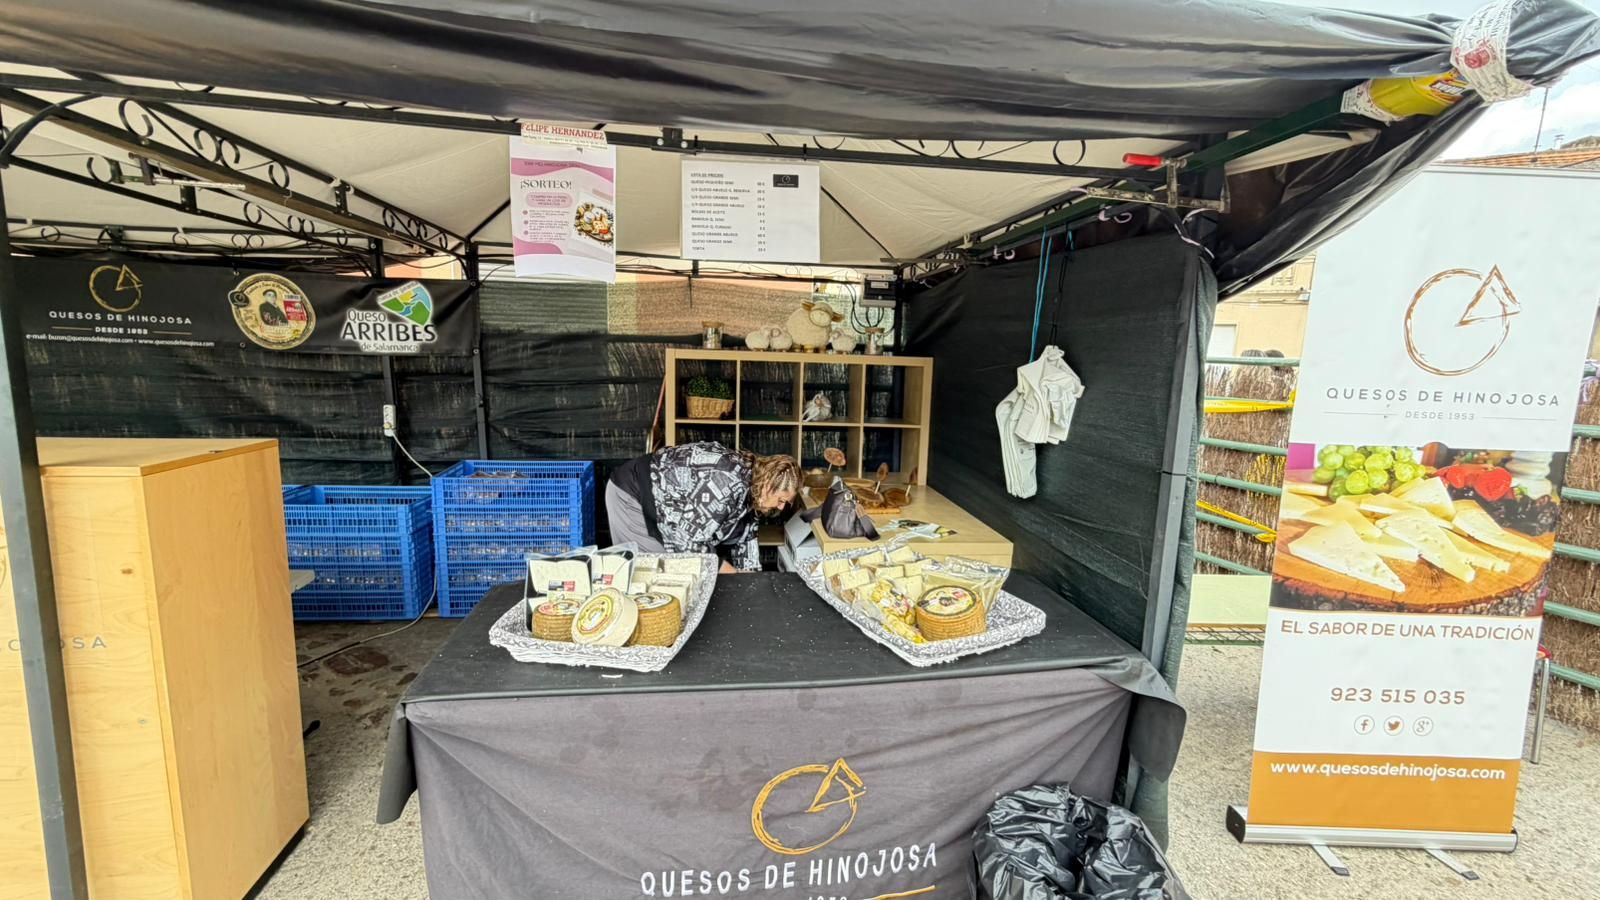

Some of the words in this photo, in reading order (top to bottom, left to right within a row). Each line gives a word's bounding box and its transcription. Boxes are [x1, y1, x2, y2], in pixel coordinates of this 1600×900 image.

[520, 179, 572, 190] ¡SORTEO!
[49, 311, 102, 321] QUESOS
[128, 315, 192, 325] HINOJOSA
[348, 309, 386, 323] Queso
[342, 322, 436, 341] ARRIBES
[373, 343, 418, 352] Salamanca
[1326, 387, 1407, 402] QUESOS
[1418, 390, 1443, 403] DE
[1453, 391, 1559, 407] HINOJOSA
[1405, 410, 1443, 420] DESDE
[1448, 412, 1475, 421] 1953
[1281, 620, 1303, 634] EL
[1308, 622, 1367, 636] SABOR
[1372, 623, 1395, 636] DE
[1400, 624, 1436, 638] UNA
[1440, 624, 1534, 641] TRADICIÓN
[1330, 688, 1372, 702] 923
[1380, 689, 1415, 703] 515
[1423, 690, 1465, 705] 035
[1270, 762, 1505, 781] www.quesosdehinojosa.com
[640, 868, 750, 898] QUESOS
[765, 862, 796, 889] DE
[809, 843, 937, 886] HINOJOSA
